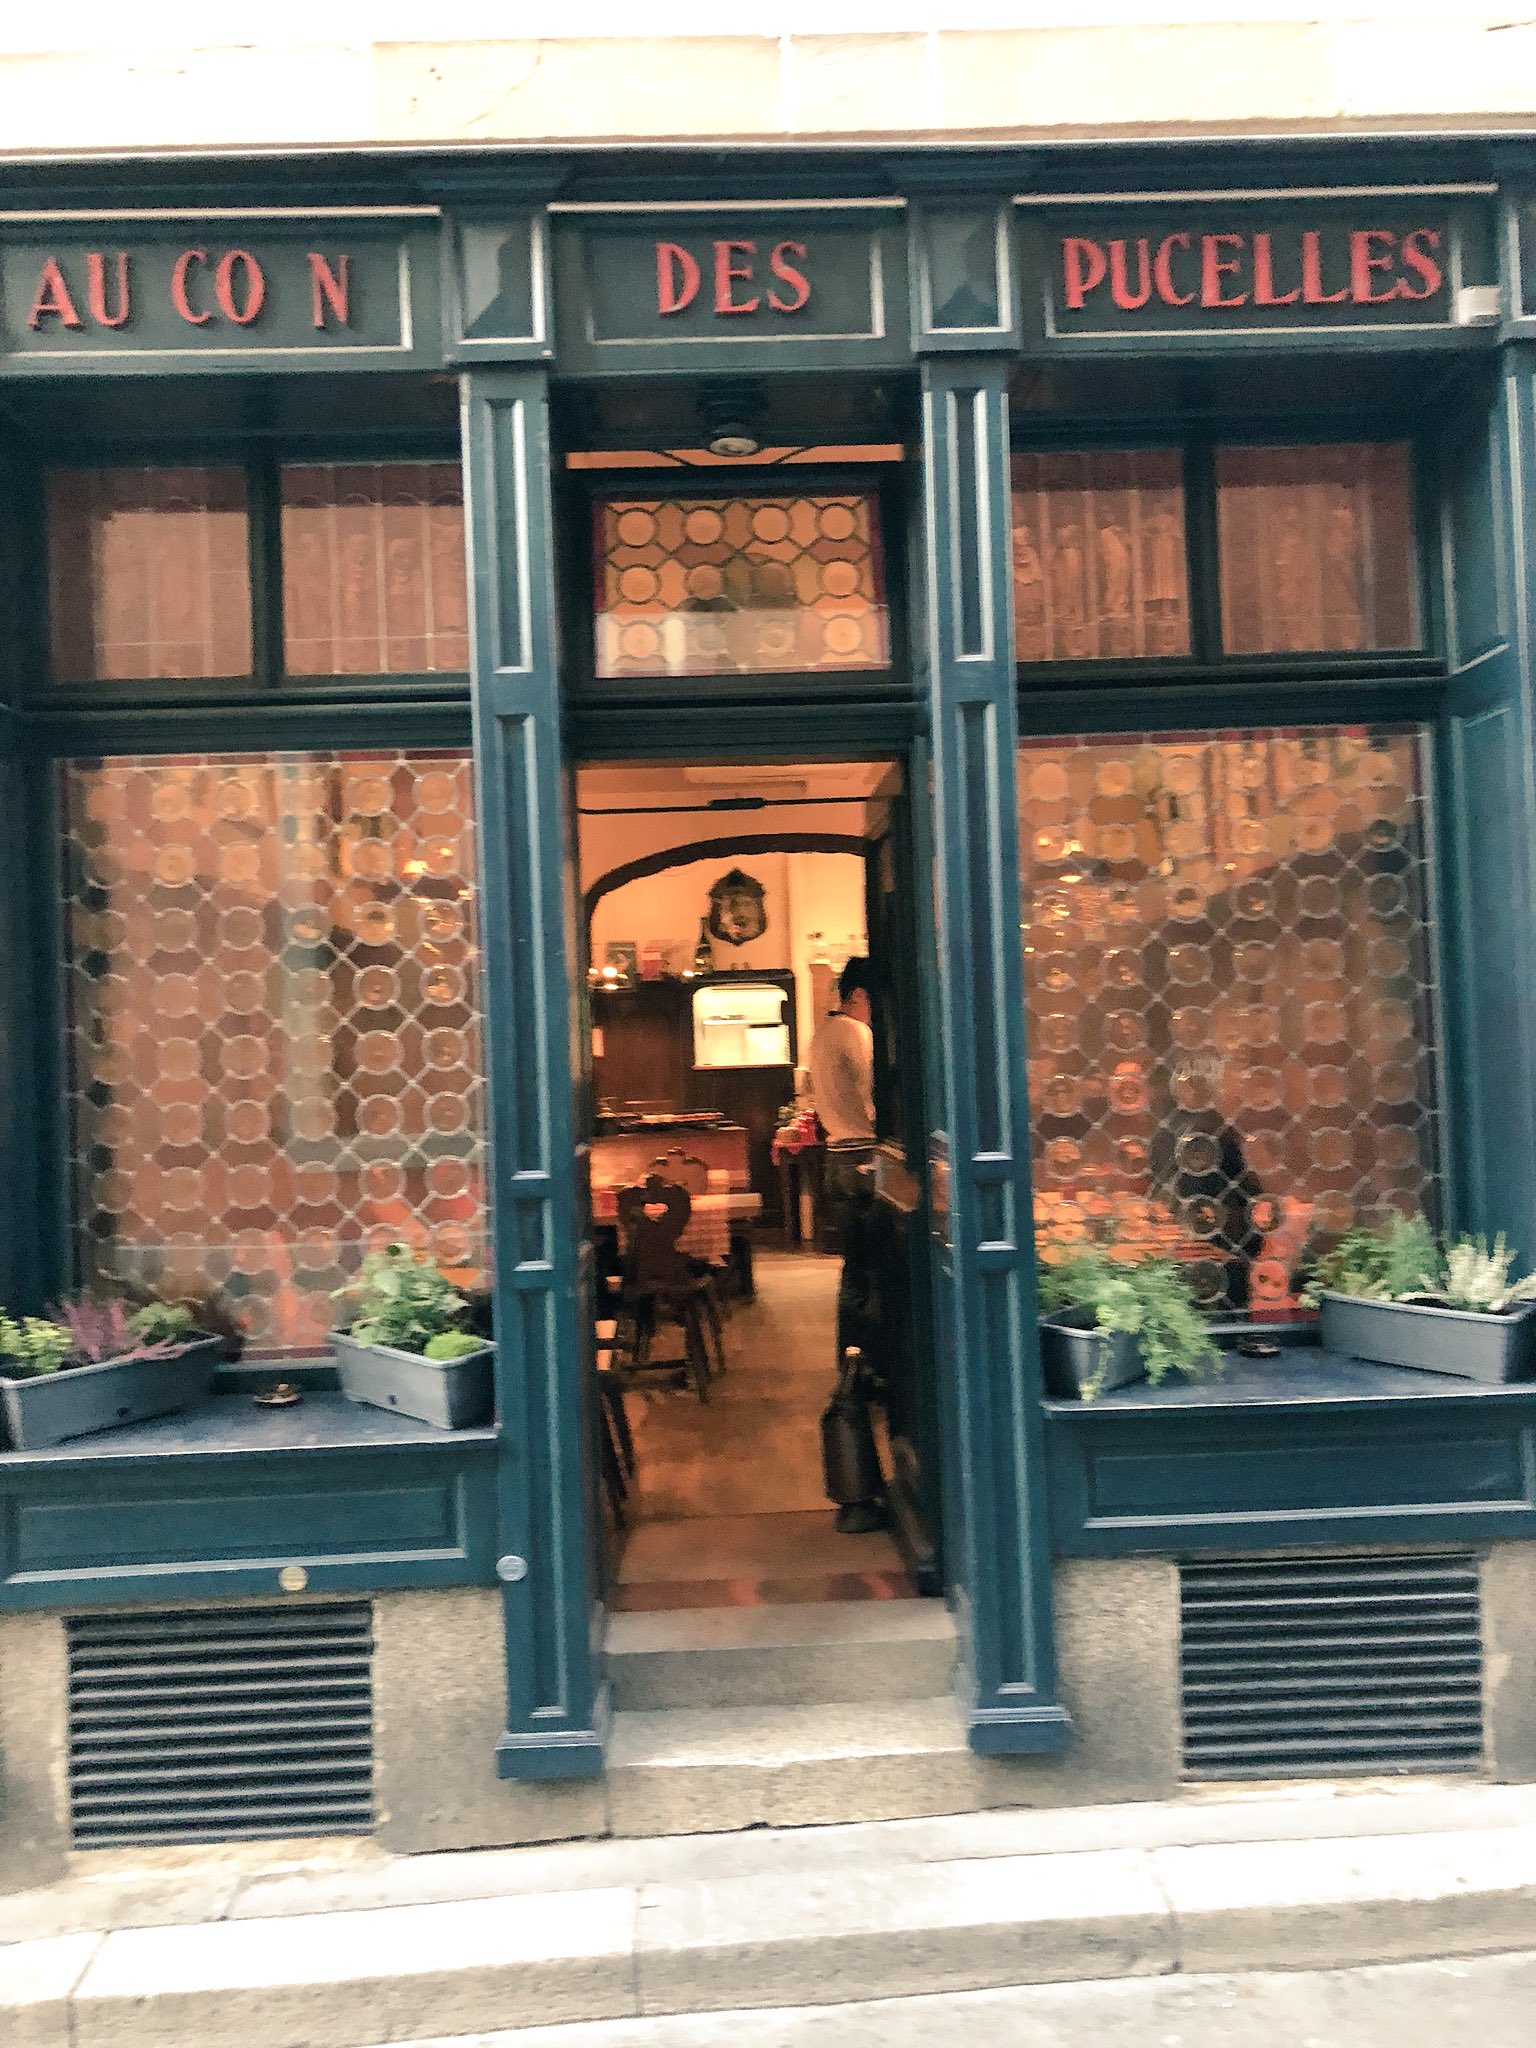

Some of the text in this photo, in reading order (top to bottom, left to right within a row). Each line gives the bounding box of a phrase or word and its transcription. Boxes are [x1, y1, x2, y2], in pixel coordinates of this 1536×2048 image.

[28, 251, 130, 328] AU
[656, 240, 811, 314] DES
[1062, 228, 1442, 310] PUCELLES
